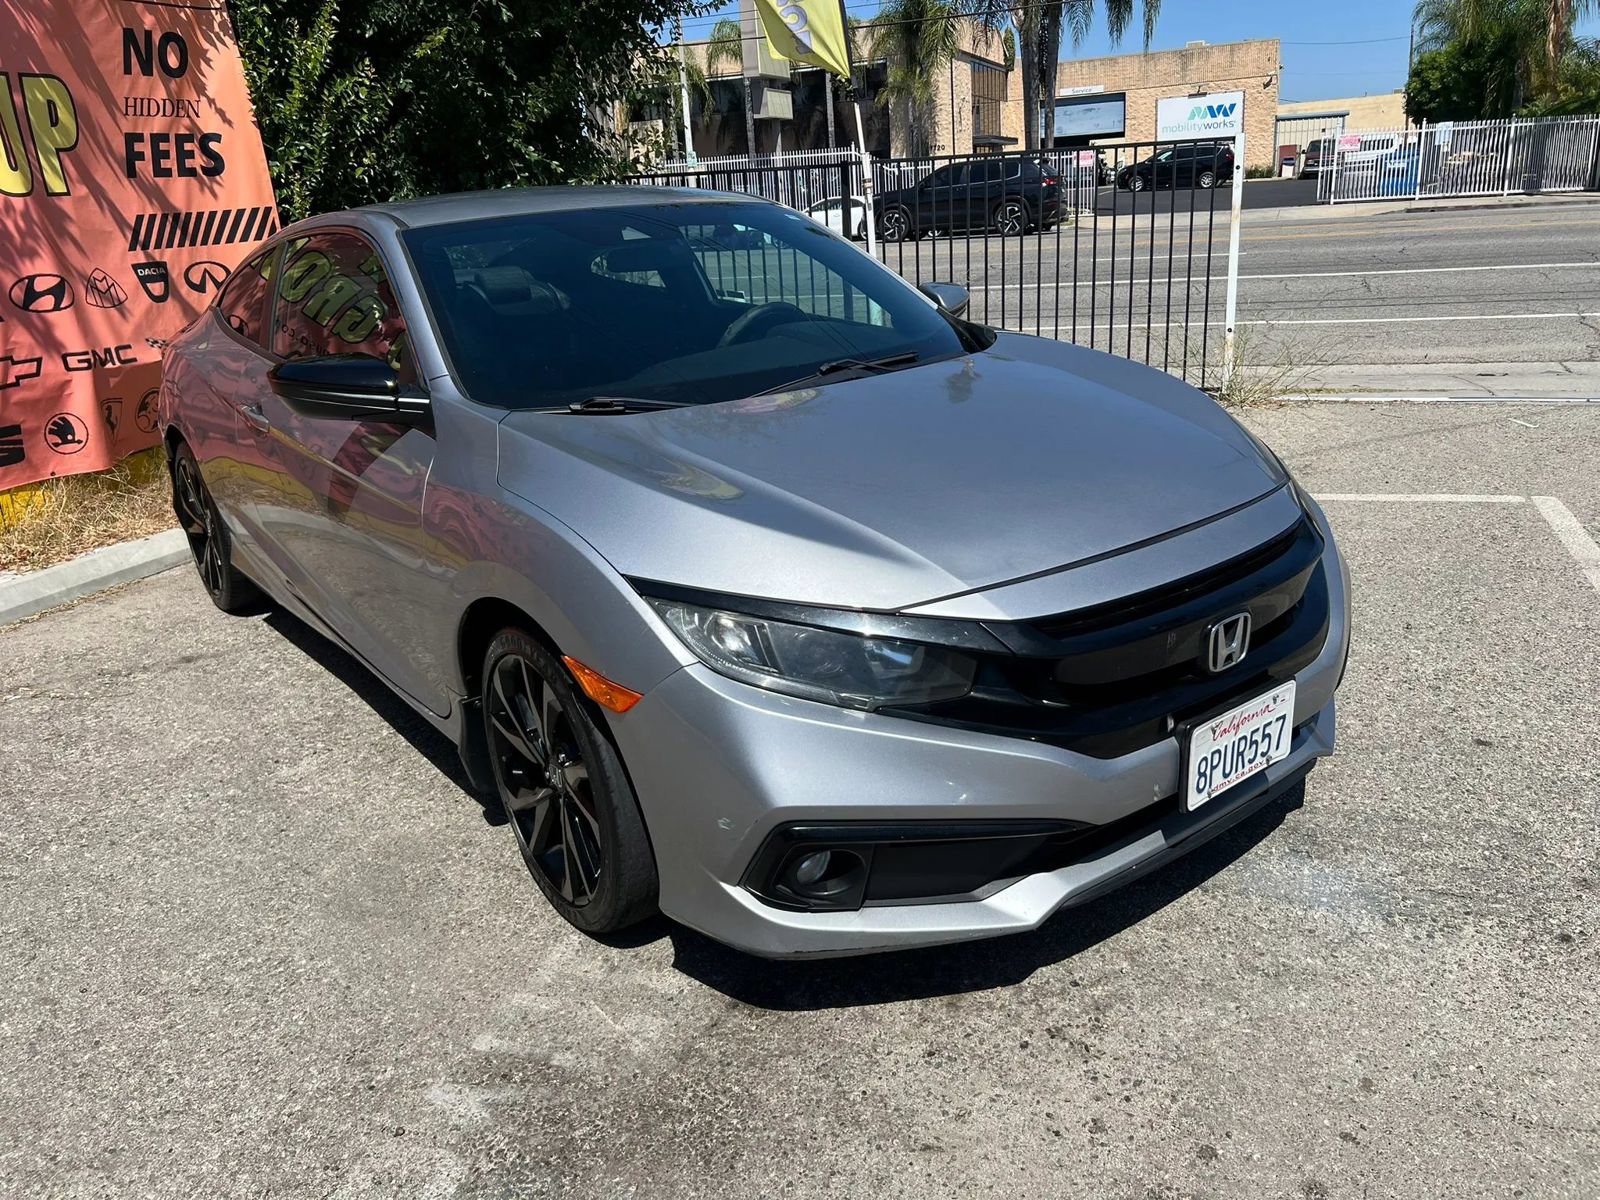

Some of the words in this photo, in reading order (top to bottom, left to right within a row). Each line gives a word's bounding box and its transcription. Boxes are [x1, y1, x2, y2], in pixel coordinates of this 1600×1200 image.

[122, 27, 189, 78] NO
[123, 96, 201, 119] HIDDEN
[1161, 119, 1236, 134] mobilityworks
[124, 132, 226, 179] FEES
[137, 266, 167, 277] DACIA
[61, 343, 139, 373] GMC
[1212, 703, 1276, 742] California
[1195, 713, 1287, 795] 8PUR557
[1214, 760, 1267, 791] dmv.ca.gov
